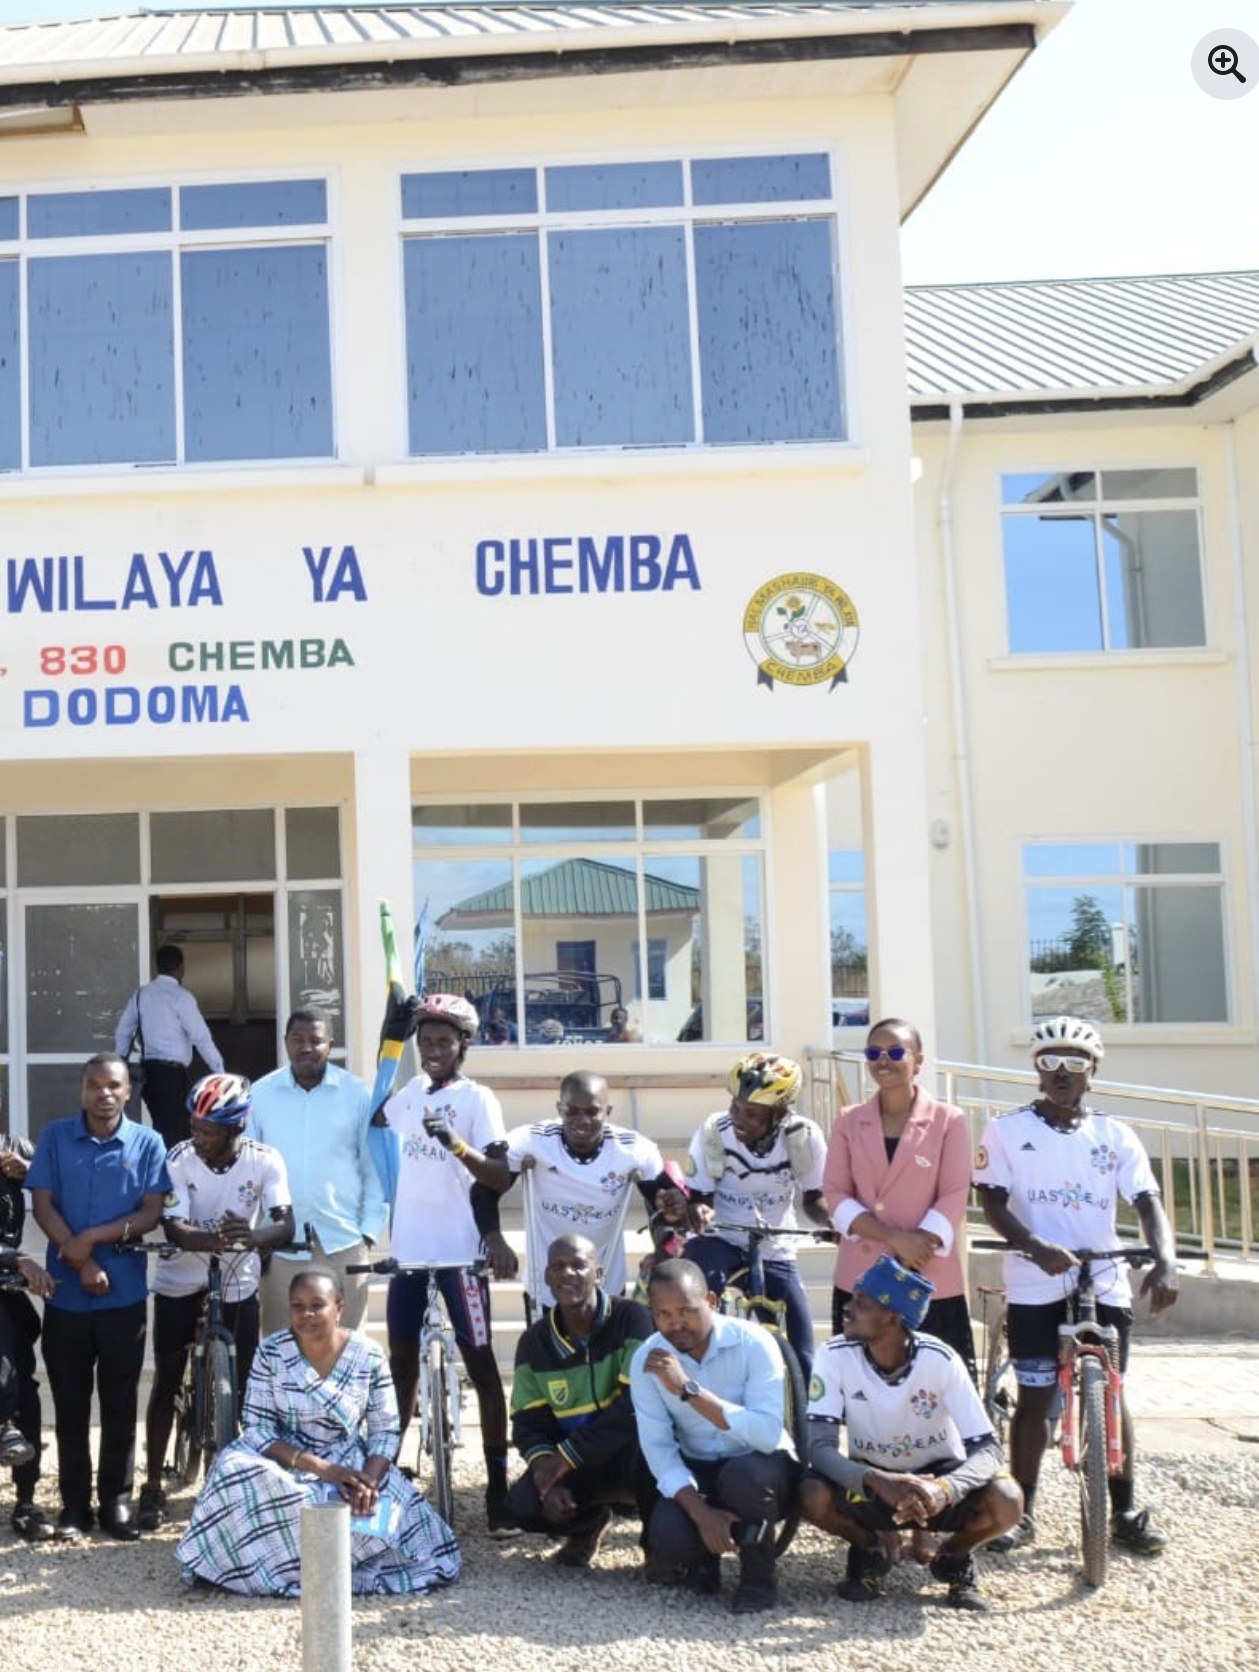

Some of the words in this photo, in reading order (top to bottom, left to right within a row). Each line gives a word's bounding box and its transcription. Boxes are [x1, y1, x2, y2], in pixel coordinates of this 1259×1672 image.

[6, 550, 223, 614] WILAYA
[302, 546, 368, 602] YA
[475, 534, 701, 596] CHEMBA
[40, 645, 127, 676] 830
[168, 638, 356, 672] CHEMBA
[23, 685, 250, 728] DODOMA
